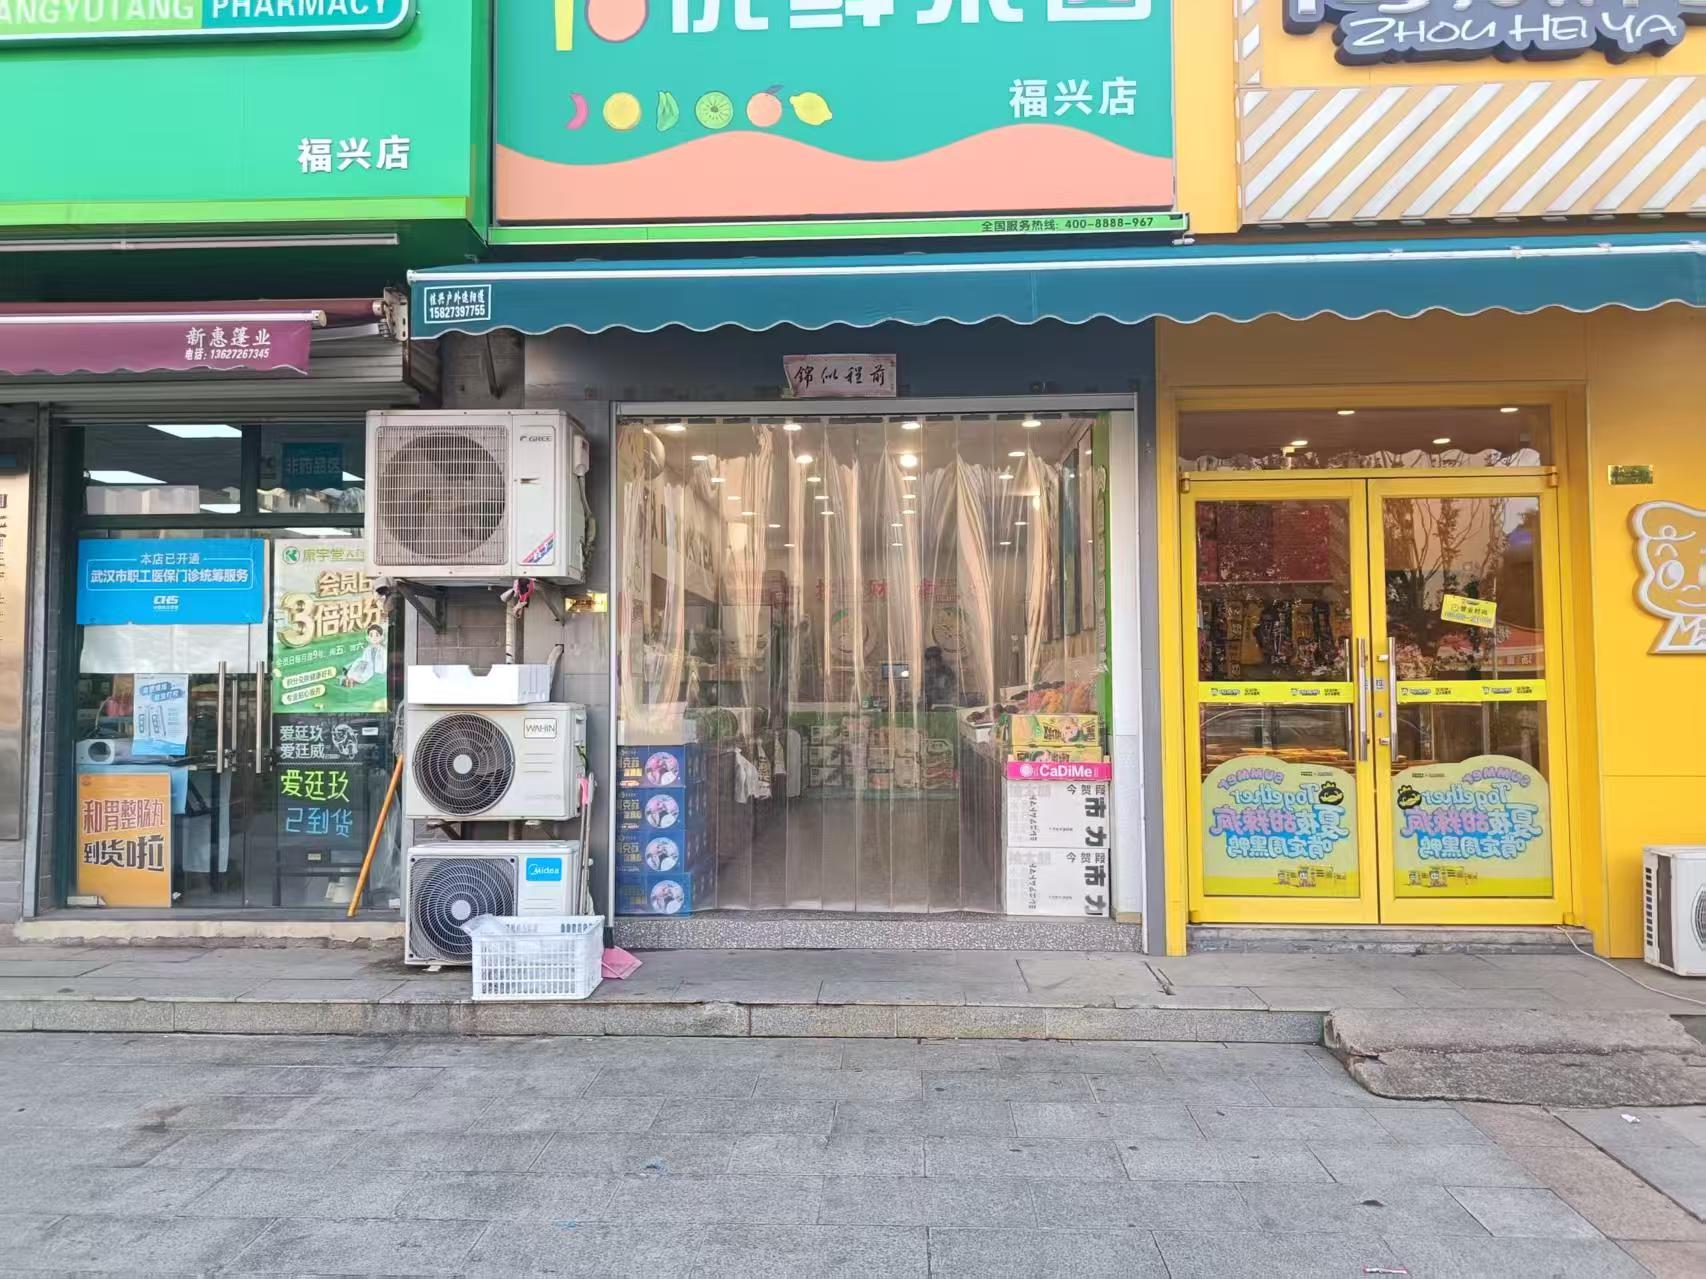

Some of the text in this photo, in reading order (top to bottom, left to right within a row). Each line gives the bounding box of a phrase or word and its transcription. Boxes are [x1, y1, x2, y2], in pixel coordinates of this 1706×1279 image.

[212, 0, 386, 18] PHARMACY
[1350, 12, 1677, 46] ZHOU HEI YA
[1008, 76, 1137, 118] 福兴店
[297, 135, 411, 173] 福兴店
[981, 217, 1153, 232] 全国服务热线: 400-8888-967
[429, 305, 486, 319] 15827397755
[210, 348, 270, 359] 13627267345
[140, 552, 200, 565] 本店已开通
[90, 568, 249, 584] 武汉市职工医保门诊统筹服务
[525, 723, 556, 733] WAHIN
[1039, 765, 1093, 778] CaDiMe
[83, 799, 165, 835] 和胃整肠丸
[83, 834, 165, 872] 到货啦
[533, 865, 560, 876] Midea
